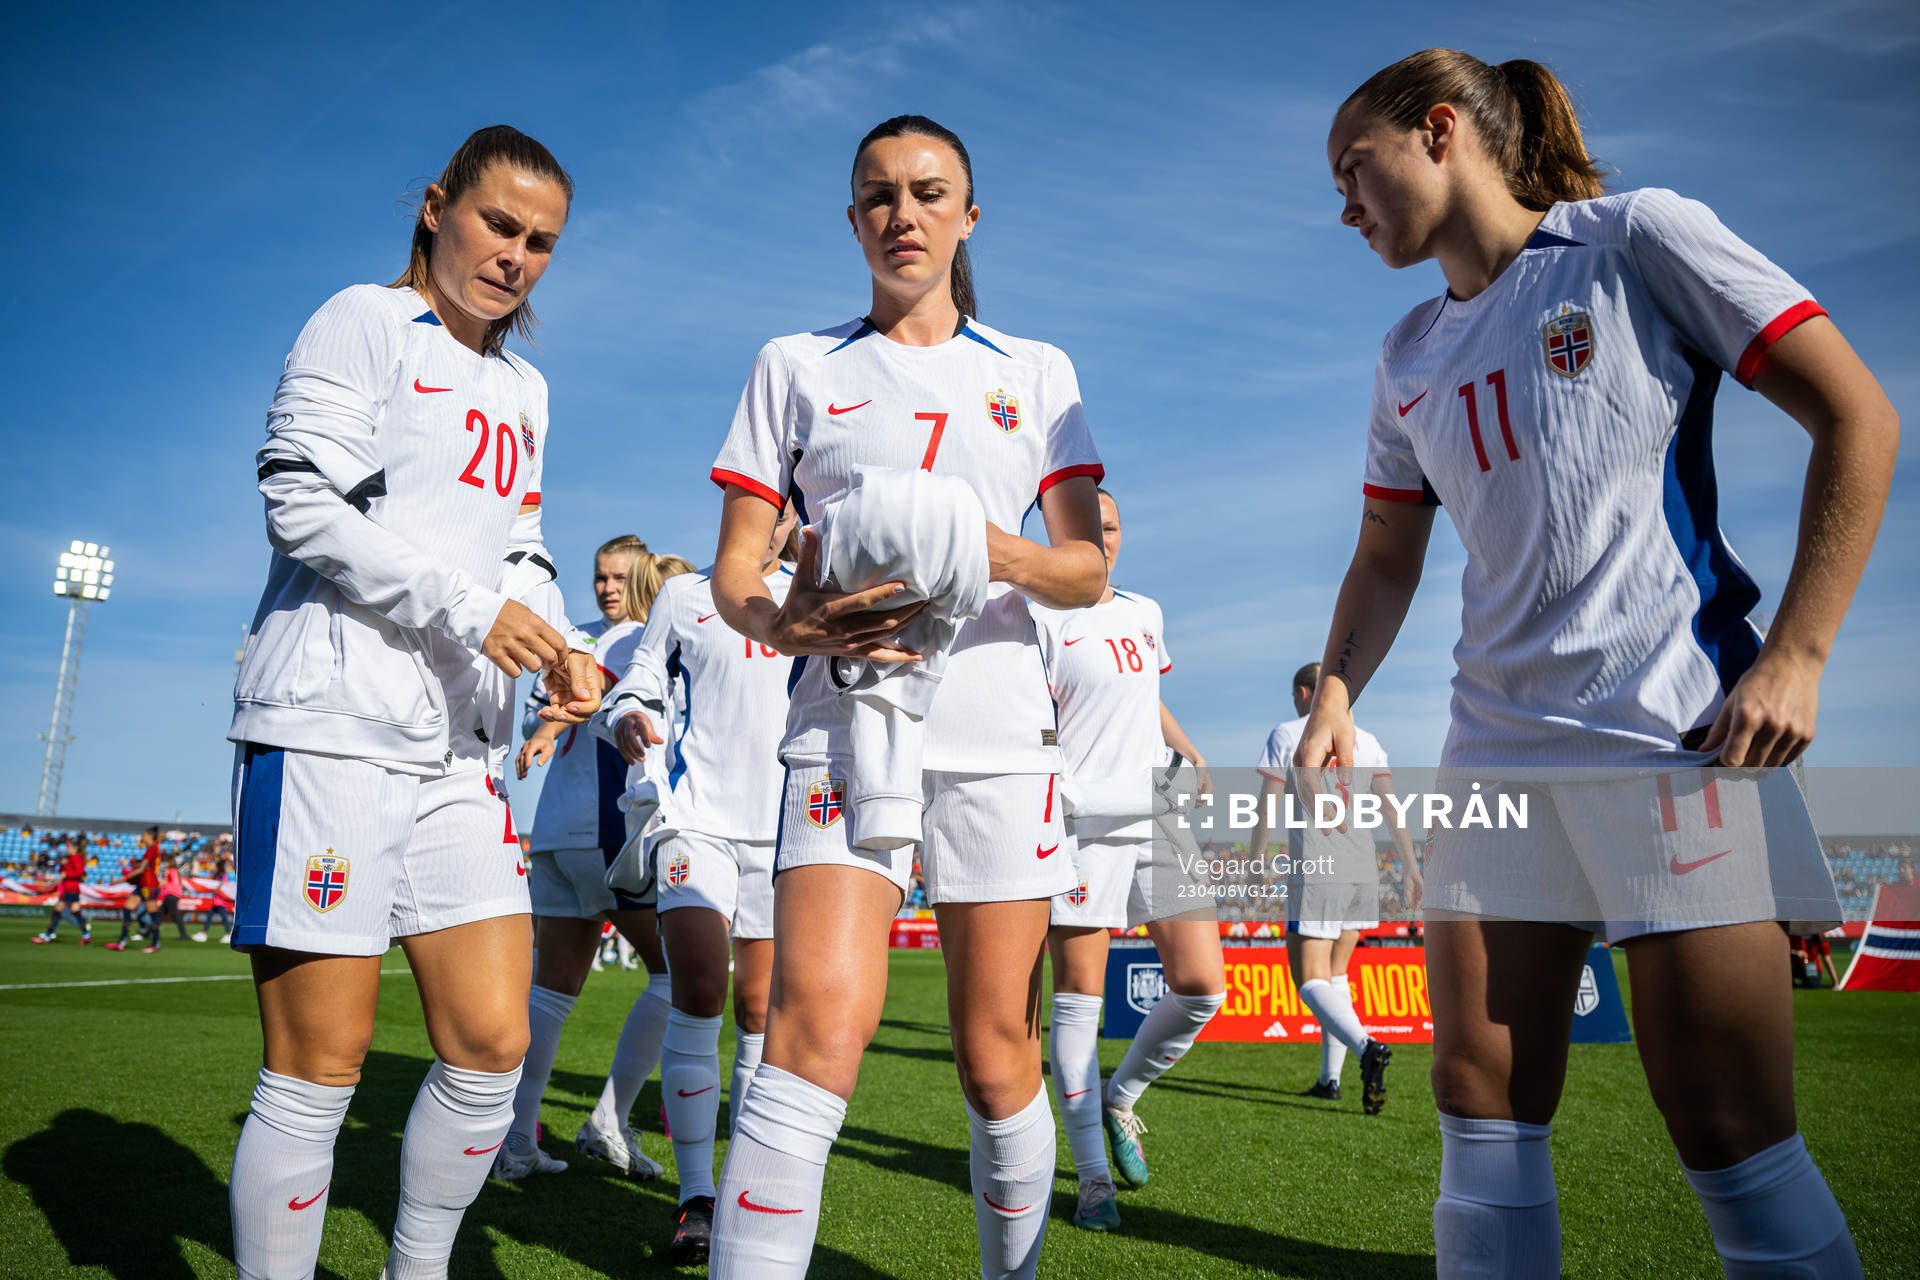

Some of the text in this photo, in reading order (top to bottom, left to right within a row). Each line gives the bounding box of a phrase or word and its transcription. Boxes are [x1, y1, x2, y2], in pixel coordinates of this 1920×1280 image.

[914, 412, 949, 472] 7
[1458, 368, 1520, 473] 11
[458, 409, 518, 498] 20
[1104, 637, 1143, 674] 18
[1360, 964, 1432, 1017] NOR
